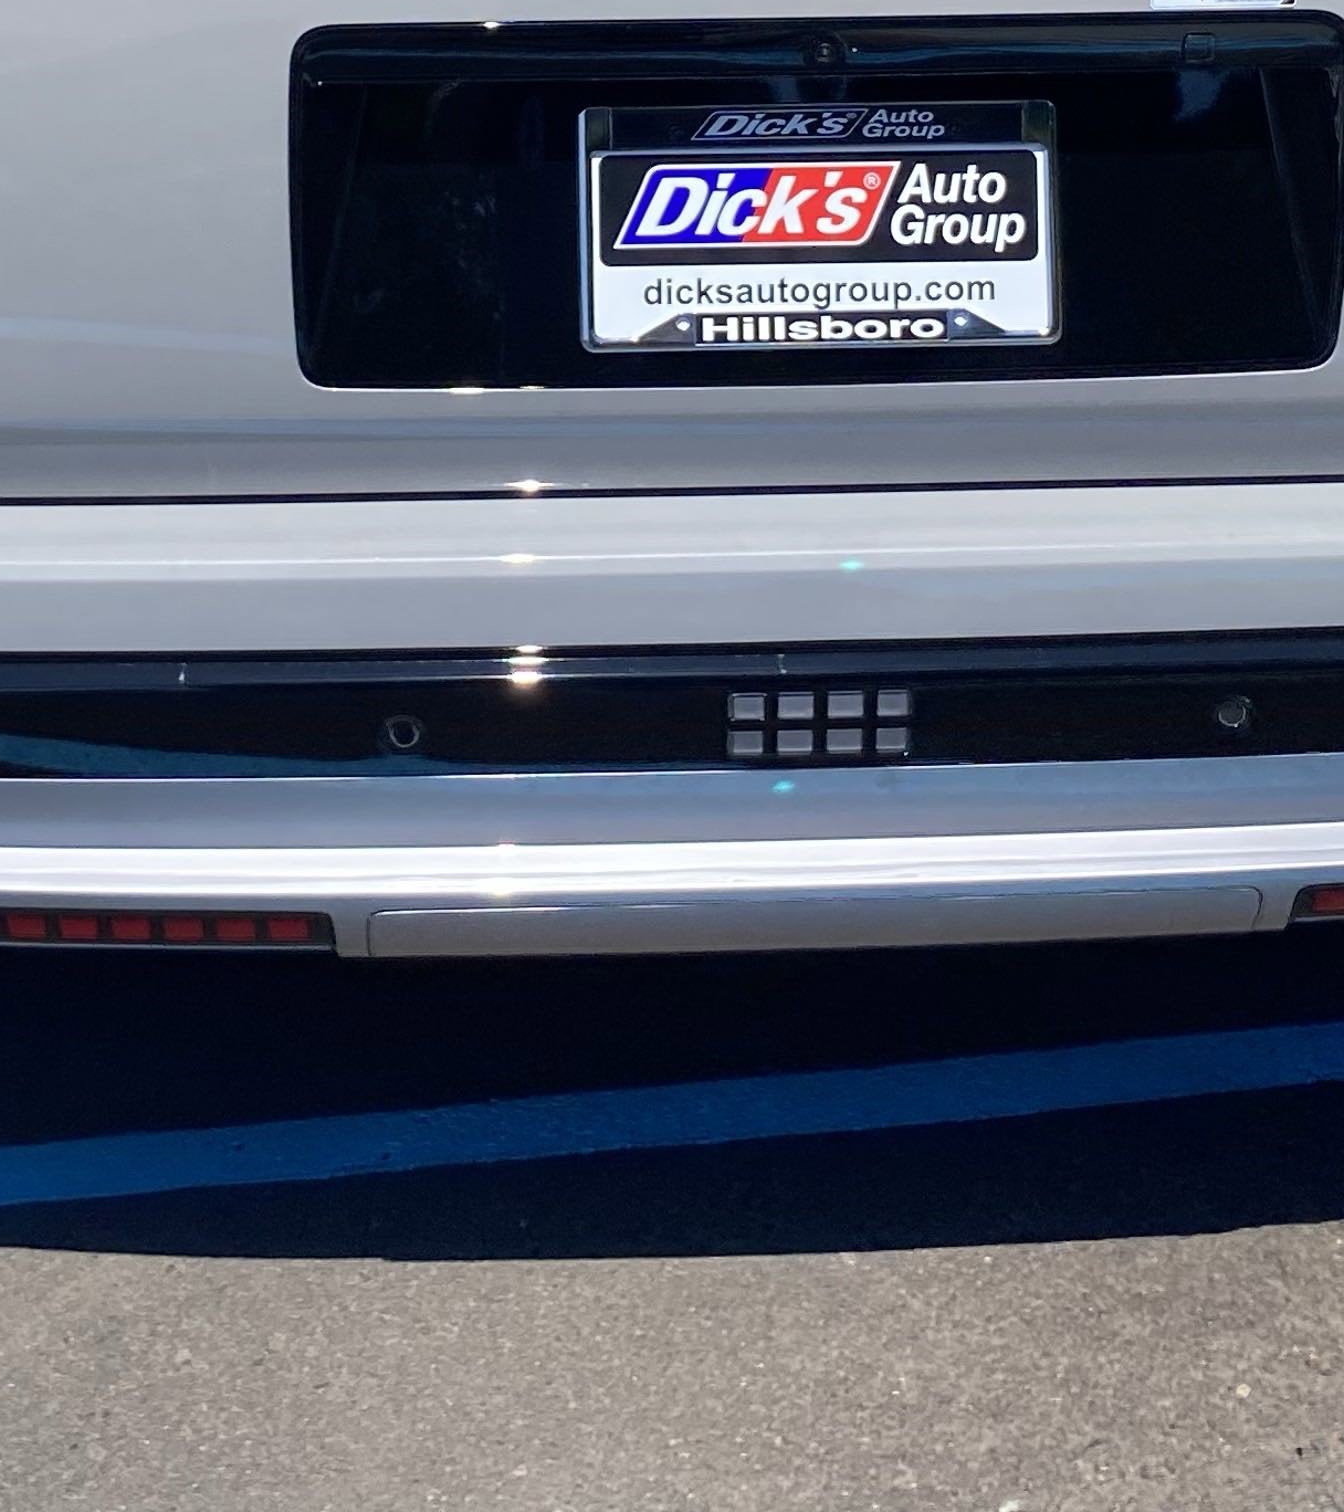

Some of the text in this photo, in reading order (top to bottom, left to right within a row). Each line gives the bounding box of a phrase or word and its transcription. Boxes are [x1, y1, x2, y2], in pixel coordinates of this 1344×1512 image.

[705, 113, 848, 136] Dick's
[862, 123, 945, 139] Group
[869, 108, 934, 124] Auto
[897, 162, 1007, 205] Auto
[634, 171, 867, 237] Dick's
[890, 205, 1026, 253] Group
[643, 277, 997, 310] dicksautogroup.com
[700, 315, 947, 343] Hillsboro
